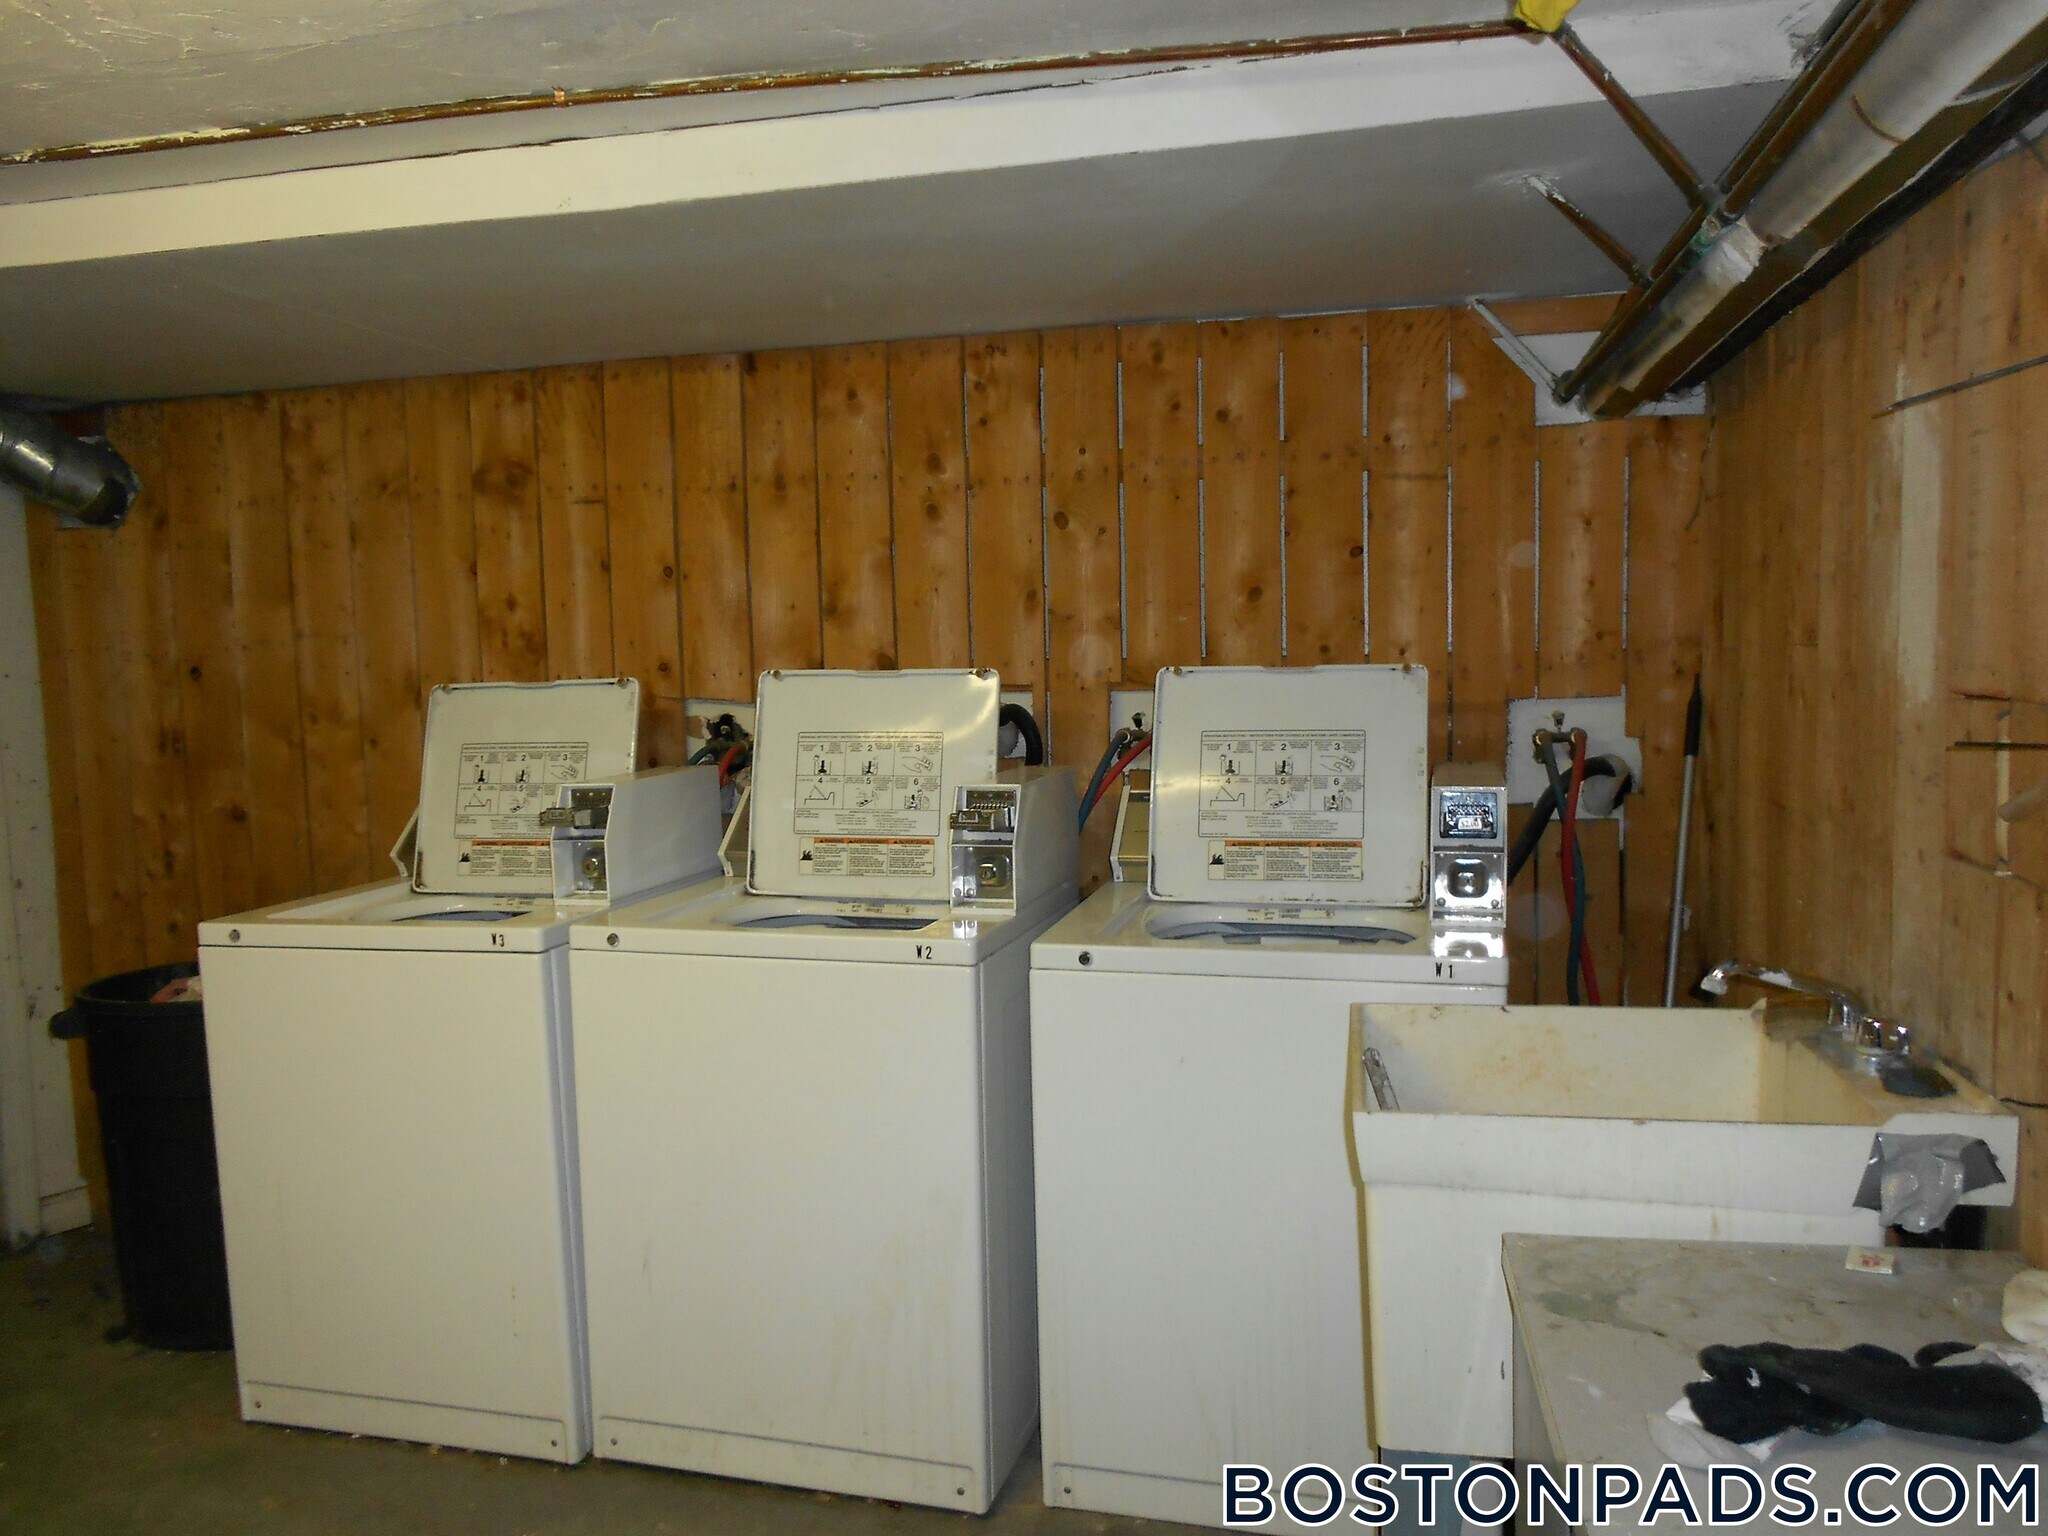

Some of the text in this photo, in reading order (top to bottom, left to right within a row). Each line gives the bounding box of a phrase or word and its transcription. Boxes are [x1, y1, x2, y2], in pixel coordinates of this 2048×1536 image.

[914, 744, 920, 752] 3
[913, 777, 919, 785] 6
[1280, 777, 1287, 785] 5
